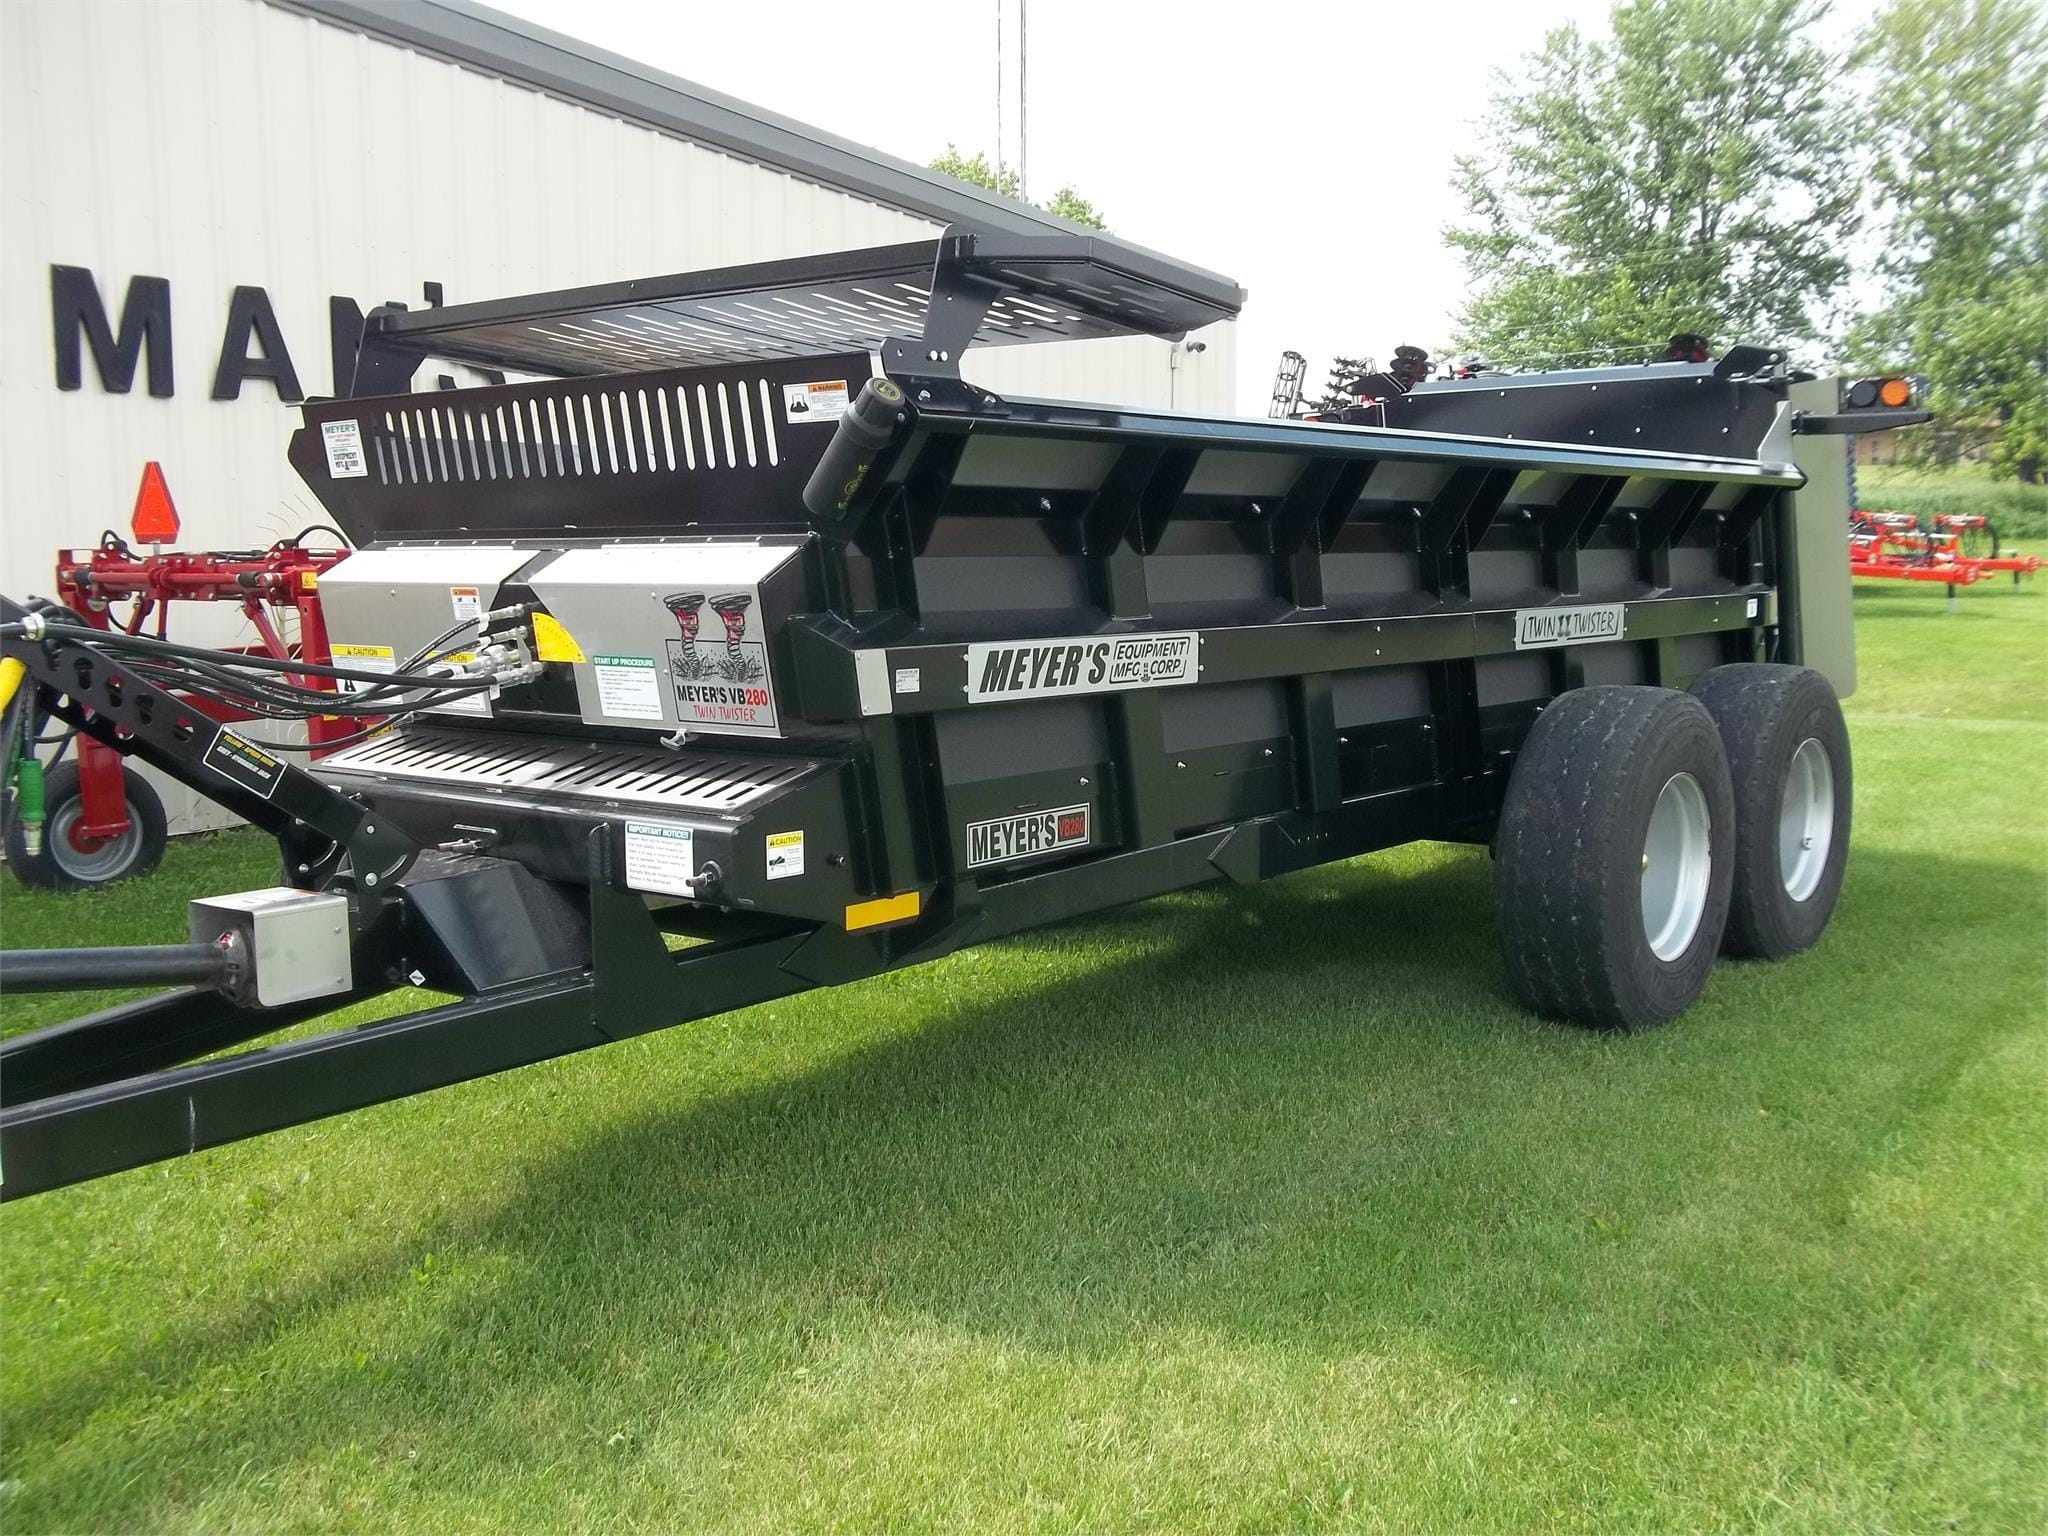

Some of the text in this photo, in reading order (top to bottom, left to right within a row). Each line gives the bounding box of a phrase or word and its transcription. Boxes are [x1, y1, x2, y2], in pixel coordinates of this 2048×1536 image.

[325, 424, 356, 433] MEYER'S
[1528, 611, 1615, 638] TWIN TWISTER
[353, 647, 378, 656] CAUTION
[620, 658, 654, 667] PROCEDURE
[979, 641, 1187, 693] MEYER'S EQUIPMENT
[1113, 659, 1182, 678] MFG. CORP.
[676, 685, 728, 704] MEYER'S
[728, 687, 768, 706] VB280
[693, 705, 756, 721] TWIN TWISTER
[628, 824, 662, 837] IMPORTANT
[972, 814, 1085, 861] MEYER'S VB280
[775, 836, 802, 845] CAUTION
